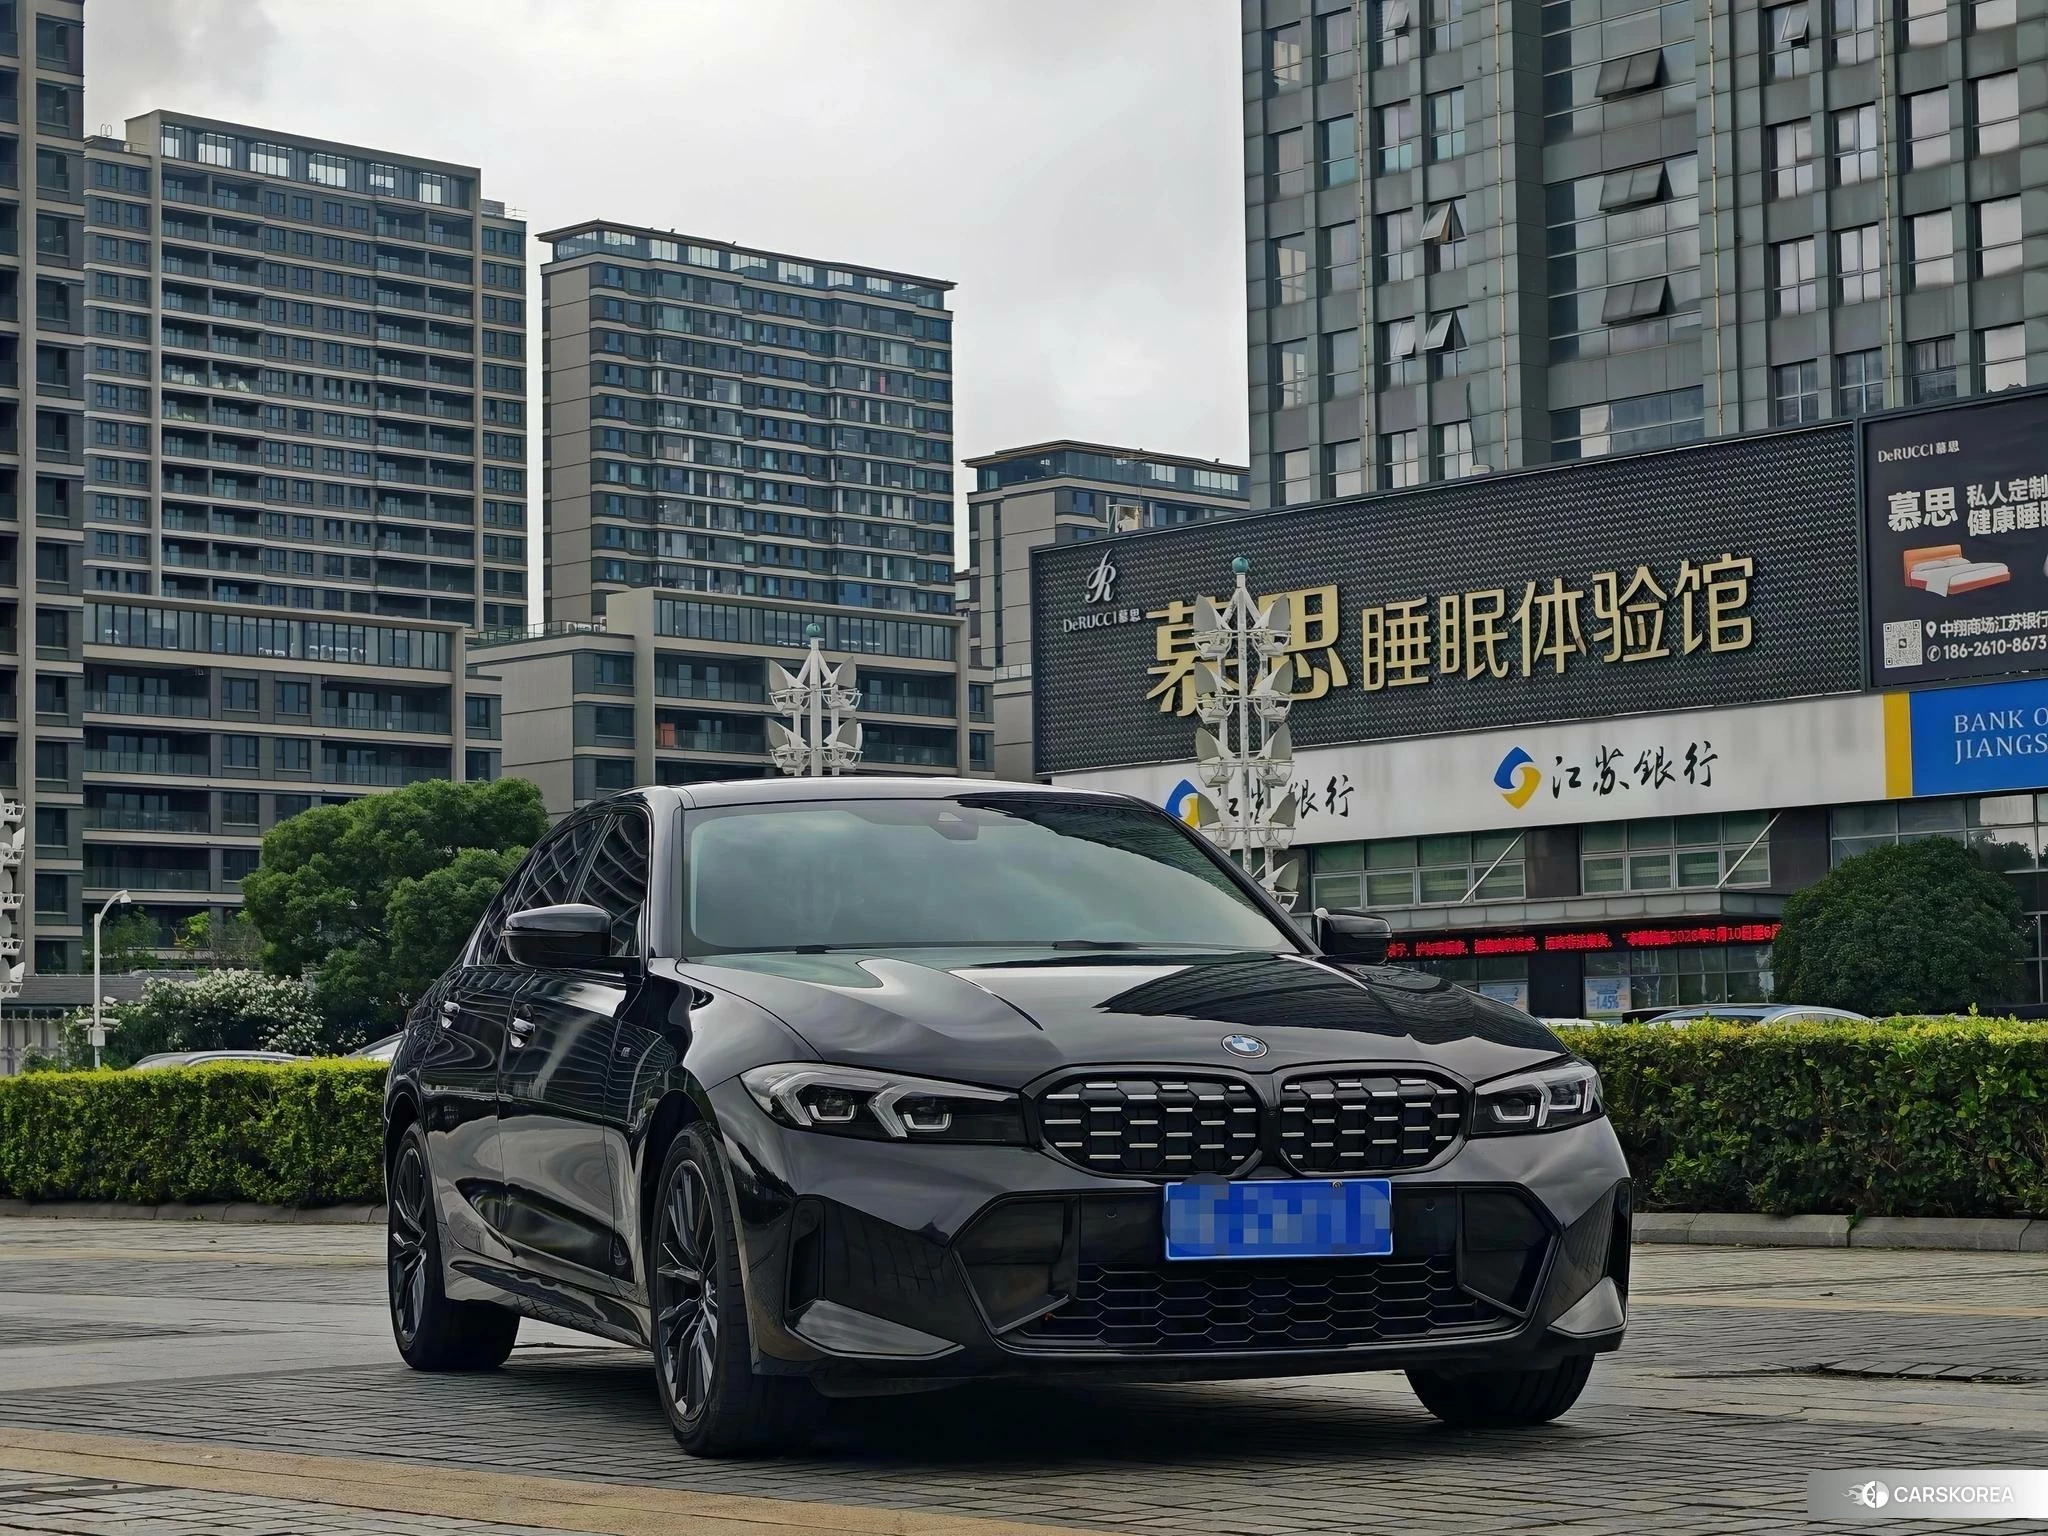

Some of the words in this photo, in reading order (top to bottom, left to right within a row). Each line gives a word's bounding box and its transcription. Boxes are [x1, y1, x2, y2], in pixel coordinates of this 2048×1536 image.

[1877, 443, 1934, 463] DeRUCCI
[1888, 486, 1959, 532] 慕思
[1063, 611, 1117, 633] DeRUCCI
[1954, 709, 2024, 734] BANK
[1955, 733, 2048, 765] JIANGS
[1551, 740, 1719, 799] 江苏银行
